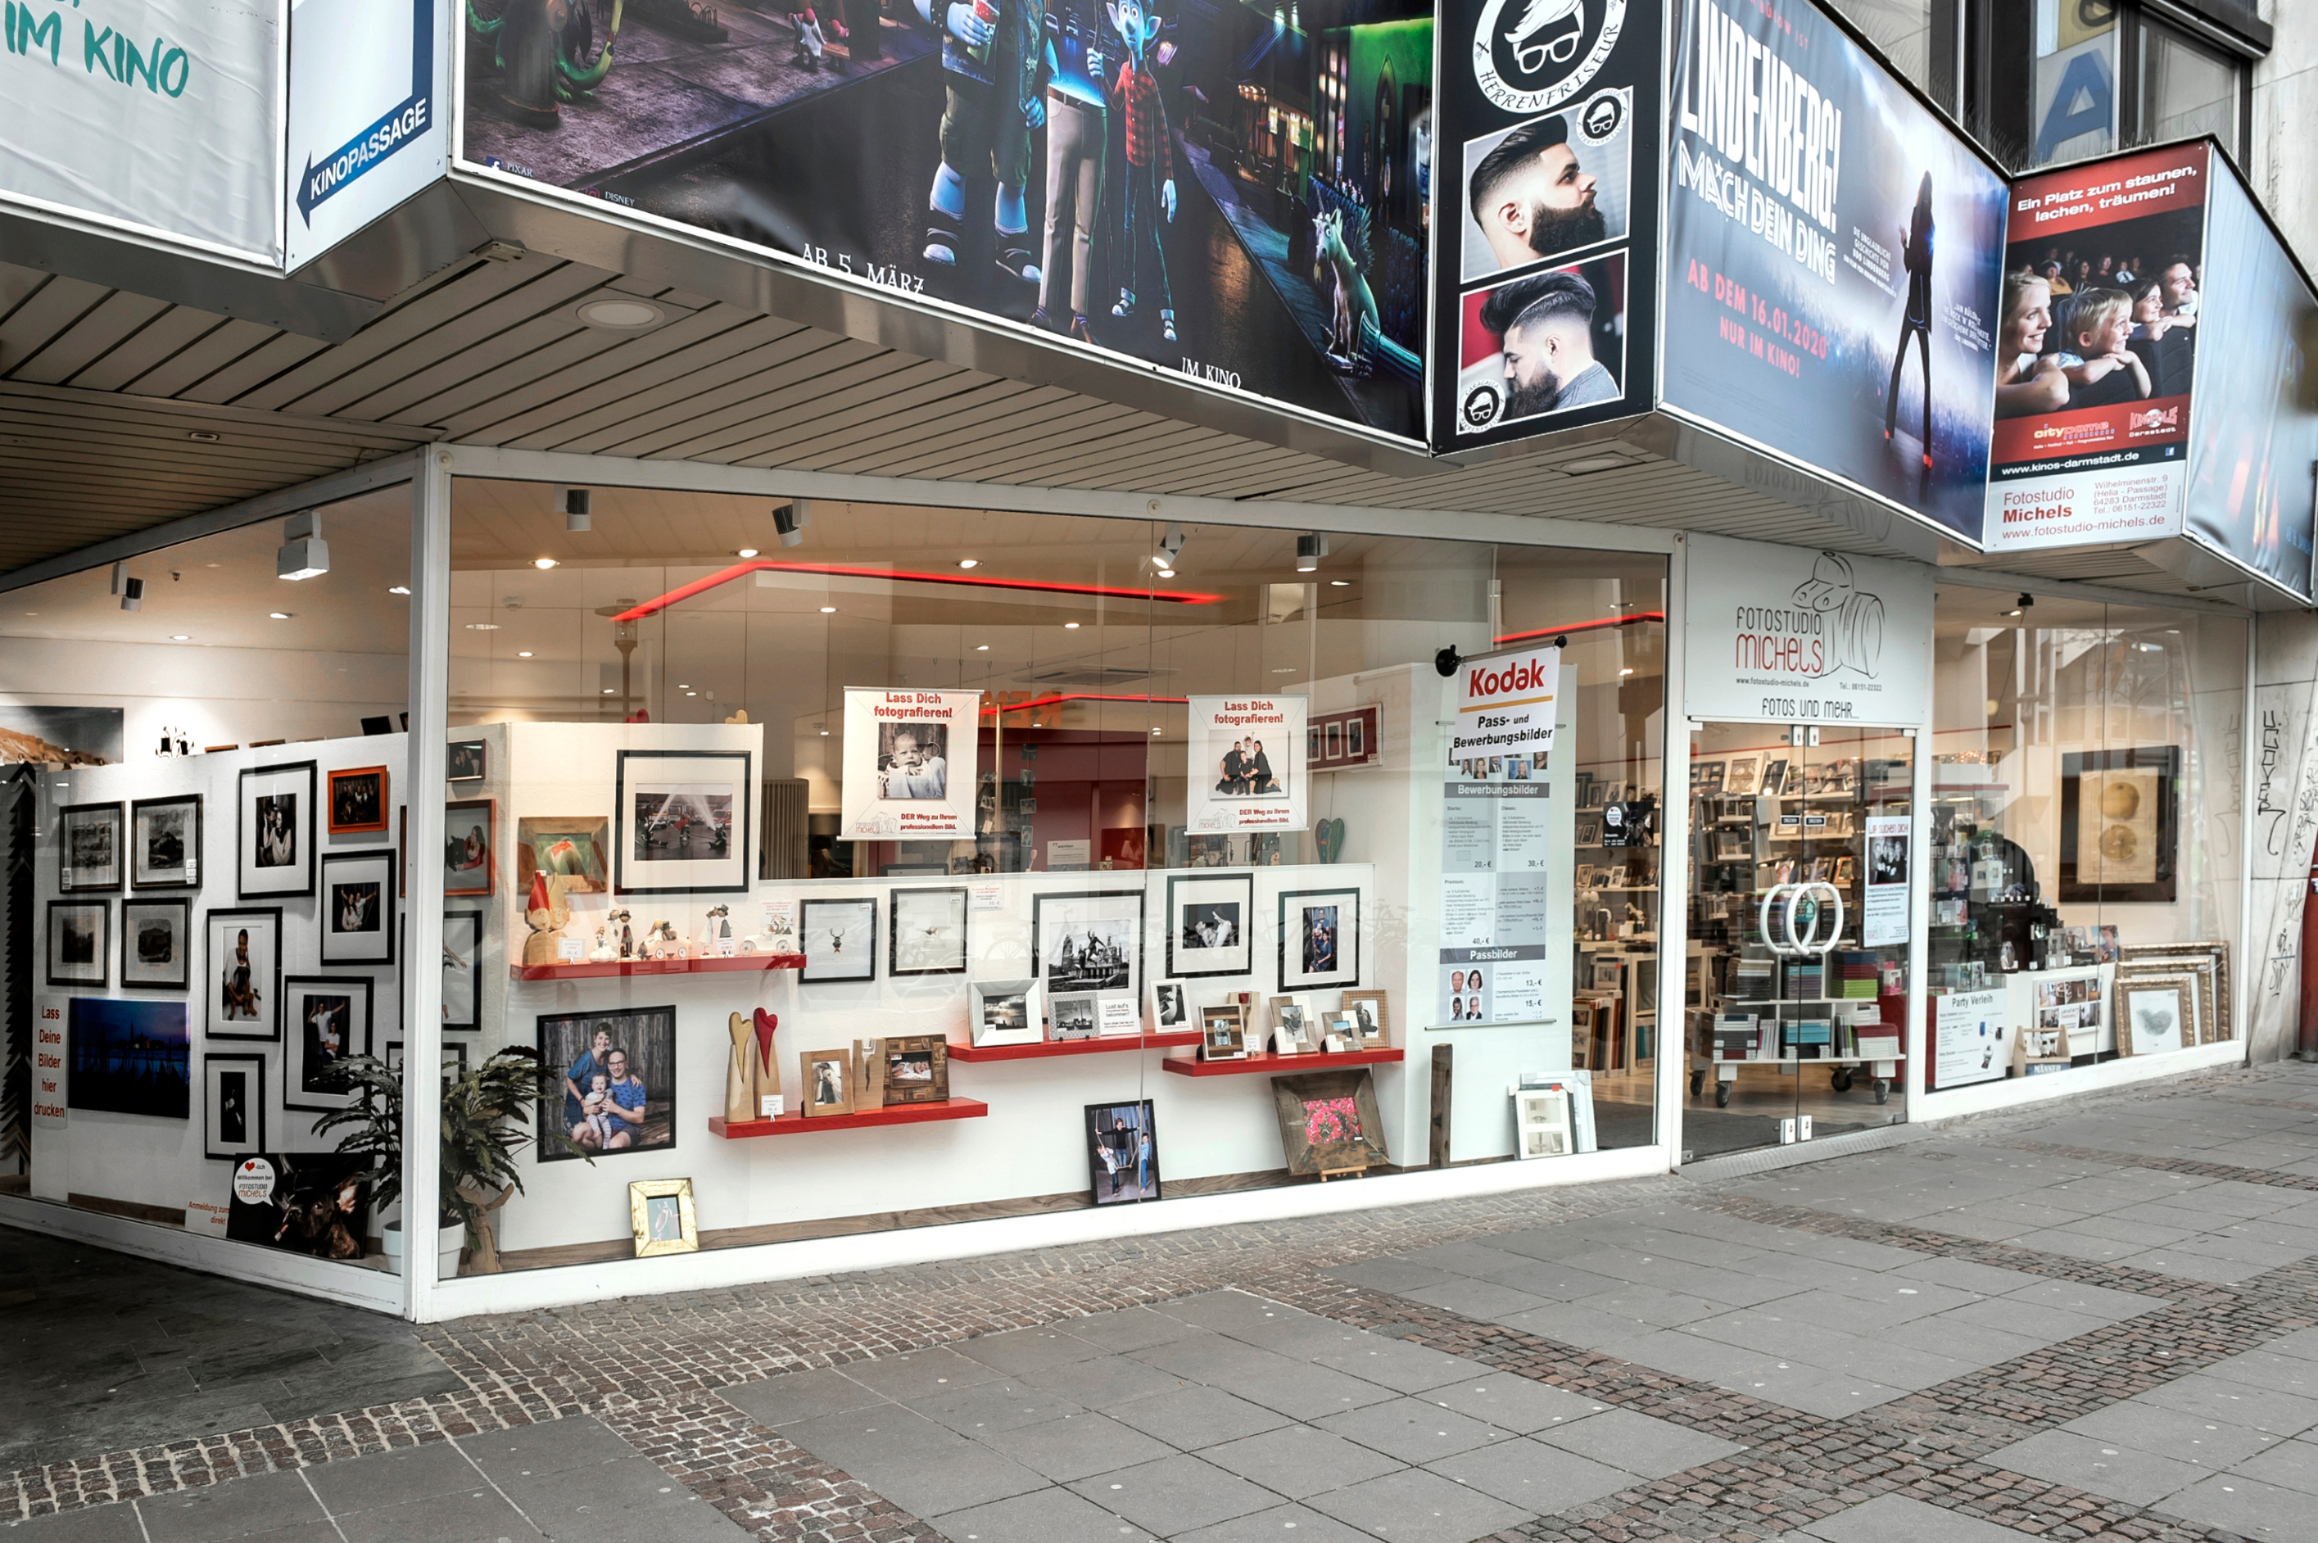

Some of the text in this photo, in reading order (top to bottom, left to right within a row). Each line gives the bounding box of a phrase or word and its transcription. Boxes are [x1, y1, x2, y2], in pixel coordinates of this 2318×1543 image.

[5, 0, 189, 98] IM KINO
[1480, 24, 1618, 109] HERRENFRISEUR
[1680, 0, 1842, 234] LINDENBERG!
[310, 98, 426, 200] KINOPASSAGE
[507, 162, 533, 178] PIXAR
[2018, 166, 2197, 211] Ein Platz zum staunen,
[605, 191, 635, 206] DISNEY
[2035, 183, 2175, 223] lachen, träumen!
[1678, 139, 1749, 226] MACH
[1751, 187, 1793, 255] DEIN
[1795, 218, 1836, 285] DING
[1853, 226, 1861, 238] DIE
[1855, 239, 1889, 271] GESCHICHTE VON
[802, 243, 828, 268] AB
[867, 262, 924, 294] MÄRZ
[1863, 253, 1890, 282] LINDENBERG
[1688, 258, 1827, 360] AB DEM 16.01.2020
[1720, 316, 1800, 378] NUR IM KINO!
[1182, 357, 1241, 389] IM KINO
[2130, 406, 2178, 430] KINOPOLIS
[2129, 427, 2176, 437] Darmstadt
[2002, 452, 2139, 475] www.kinos-darmstadt.de
[2095, 474, 2168, 489] Wilhelminenstr. 9
[2004, 487, 2074, 505] Fotostudio
[2093, 492, 2166, 506] 64283 Darmstadt
[2094, 489, 2119, 499] (Helia
[2127, 484, 2168, 494] Passage)
[2003, 505, 2072, 523] Michels
[2094, 500, 2166, 514] Tel.: 06151-22322
[2002, 515, 2165, 539] www.fotostudio-michels.de
[1737, 606, 1821, 635] FOTOSTUDIO
[1469, 658, 1545, 698] Kodak
[1736, 677, 1809, 688] www.fotostudio-michels.de
[886, 692, 941, 704] Lass Dich
[874, 706, 952, 719] fotografieren!
[1225, 701, 1273, 711] Lass Dich
[1762, 698, 1795, 717] FOTOS
[1215, 713, 1283, 726] fotografieren!
[1478, 714, 1529, 729] Pass- und
[1453, 728, 1553, 748] Bewerbungsbilder
[1458, 784, 1538, 796] Bewerbungsbilder
[917, 813, 930, 821] Weg
[1253, 808, 1265, 816] Weg
[1470, 949, 1517, 960] Passbilder
[1952, 994, 1993, 1008] Party Verleih
[42, 1005, 60, 1020] Lass
[39, 1029, 61, 1044] Deine
[38, 1053, 61, 1068] Bilder
[2034, 1063, 2061, 1074] MÄNNER
[42, 1078, 56, 1093] hier
[34, 1102, 65, 1118] drucken
[188, 1201, 218, 1214] Anmeldung
[210, 1215, 226, 1225] direkt
